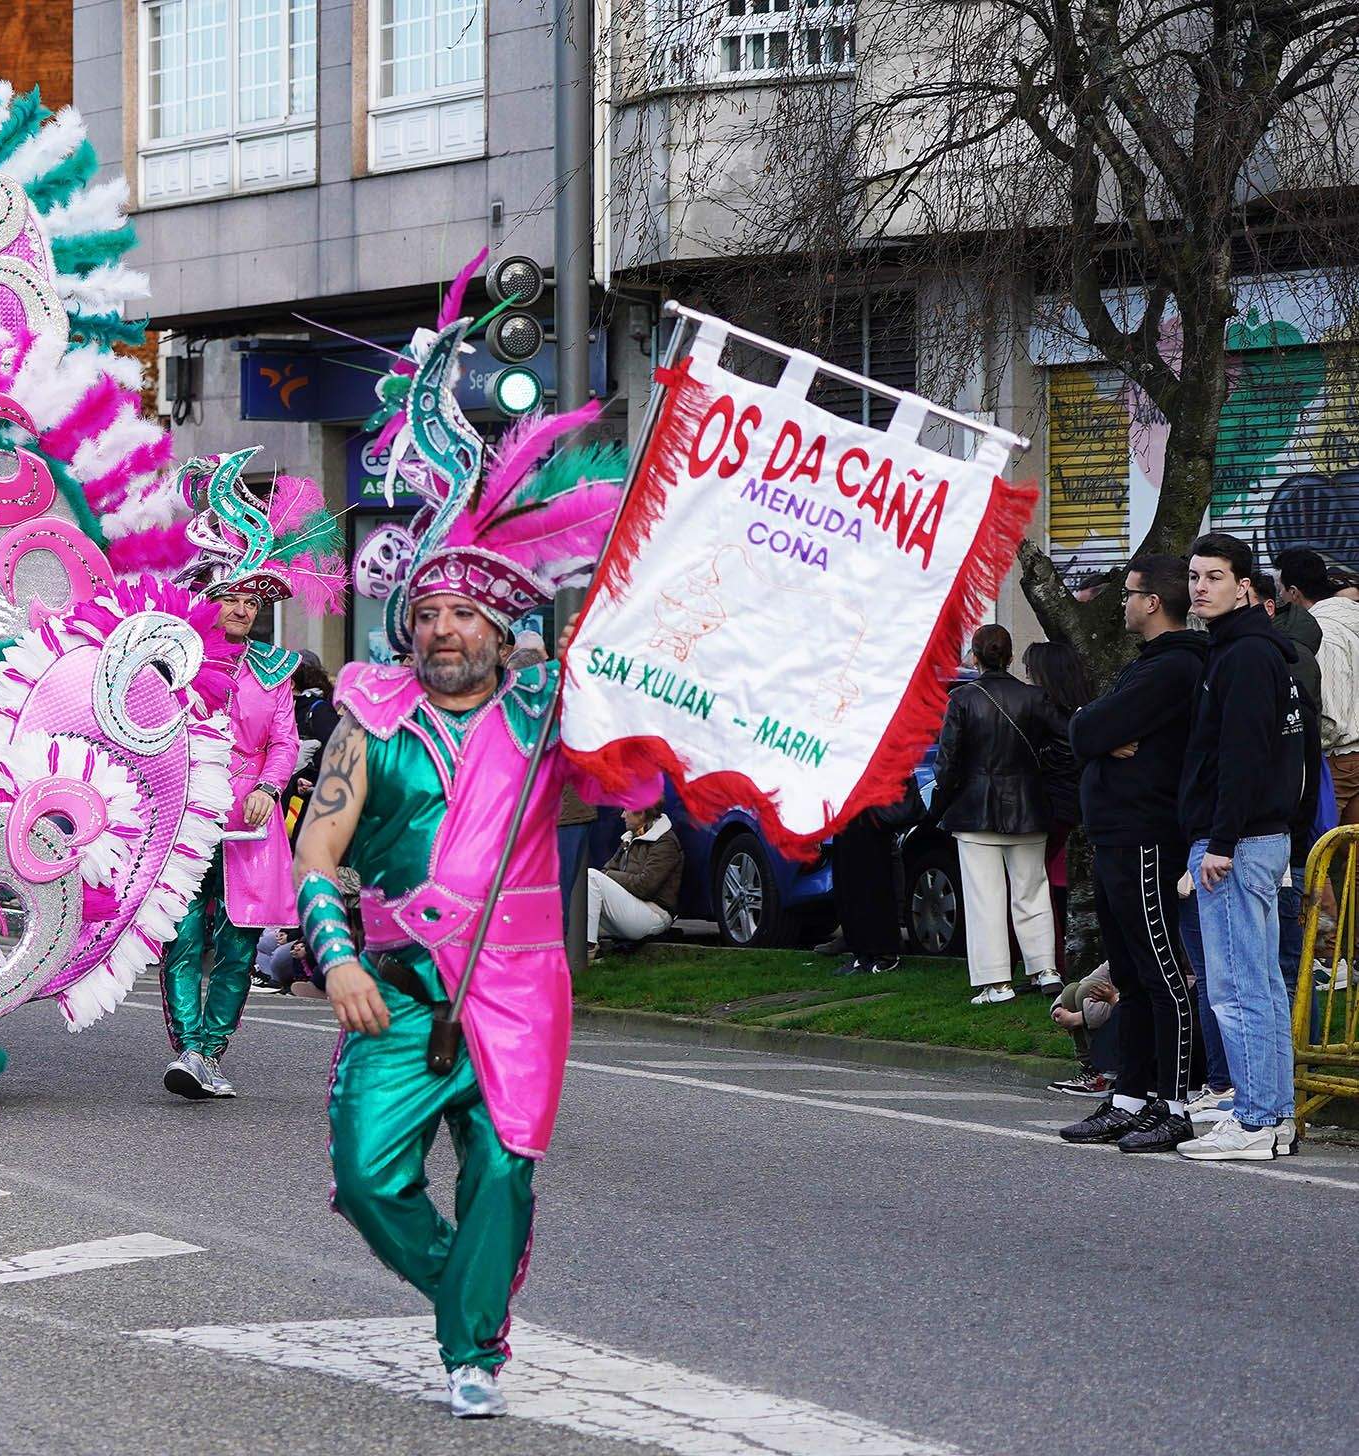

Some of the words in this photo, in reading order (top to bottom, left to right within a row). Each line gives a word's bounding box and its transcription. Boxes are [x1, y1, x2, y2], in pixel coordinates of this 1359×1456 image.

[688, 395, 762, 479] OS
[761, 420, 827, 484] DA
[836, 448, 949, 570] CAÑA
[741, 478, 862, 543] MENUDA
[747, 522, 829, 571] COÑA
[587, 646, 634, 685] SAN
[636, 663, 716, 720] XULIAN
[753, 716, 830, 768] MARIN
